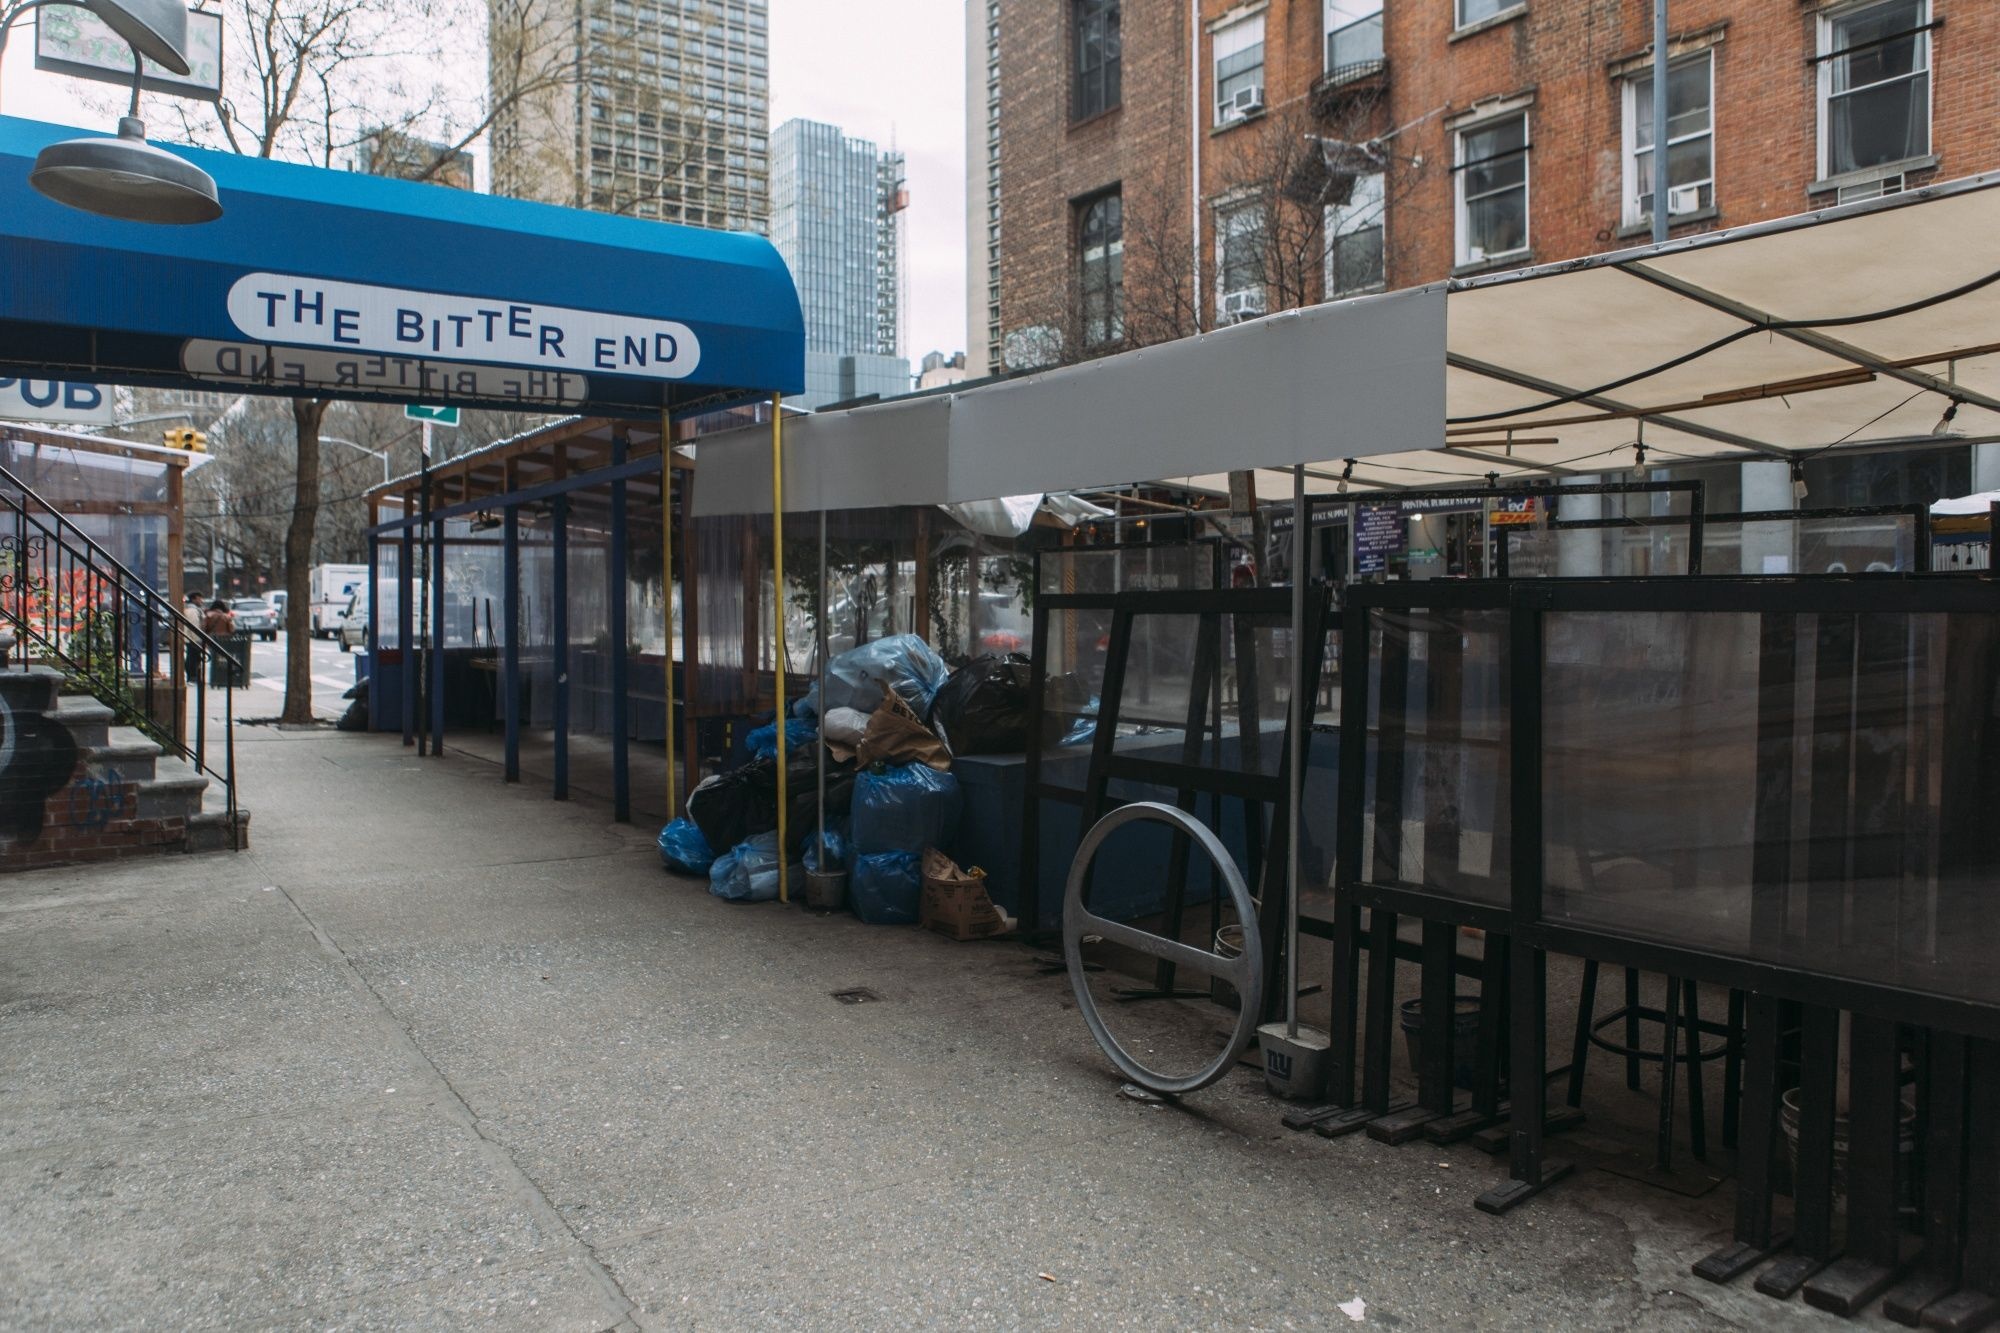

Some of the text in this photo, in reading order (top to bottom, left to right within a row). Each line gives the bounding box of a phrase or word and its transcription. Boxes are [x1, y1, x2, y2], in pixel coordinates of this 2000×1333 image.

[257, 289, 678, 369] THE BITTER END
